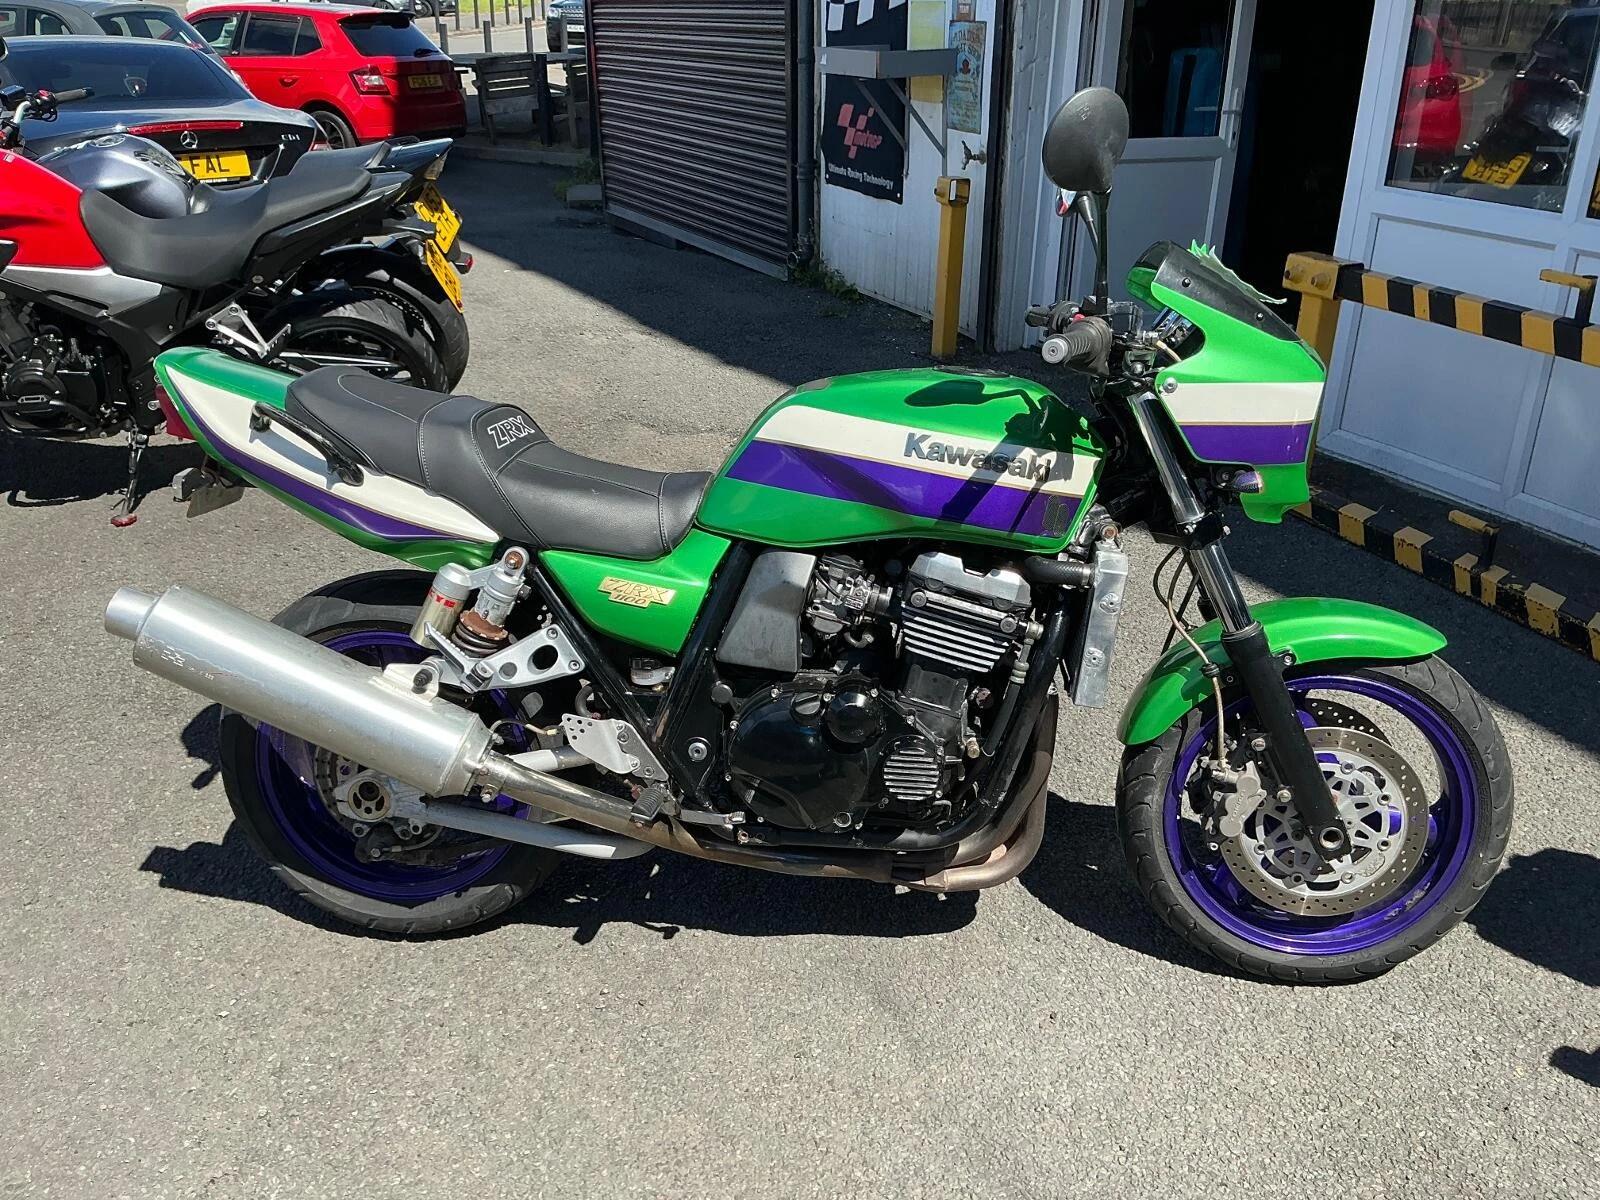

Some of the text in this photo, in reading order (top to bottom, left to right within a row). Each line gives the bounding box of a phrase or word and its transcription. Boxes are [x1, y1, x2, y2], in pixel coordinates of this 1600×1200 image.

[189, 154, 230, 174] FAL
[863, 171, 894, 190] Technology
[487, 415, 536, 449] ZRX
[903, 432, 1051, 483] Kawasaki
[606, 579, 669, 602] ZRX
[614, 594, 647, 605] 1100
